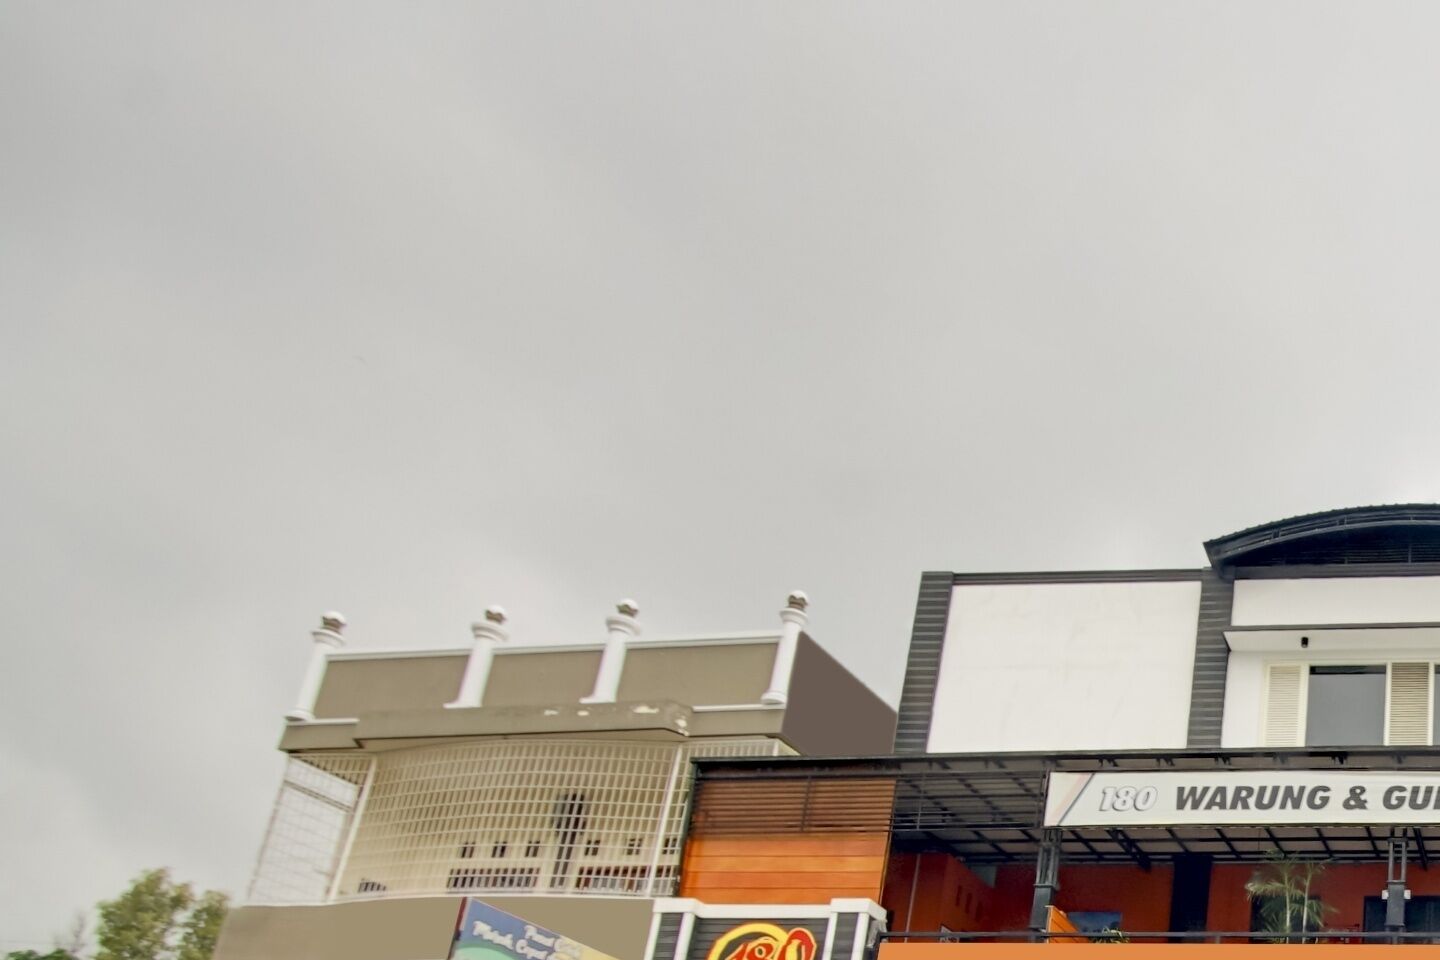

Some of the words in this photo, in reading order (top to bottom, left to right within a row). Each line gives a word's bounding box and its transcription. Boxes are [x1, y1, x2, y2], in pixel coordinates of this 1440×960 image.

[1098, 786, 1158, 812] 180
[1175, 785, 1331, 811] WARUNG
[1342, 785, 1370, 810] &
